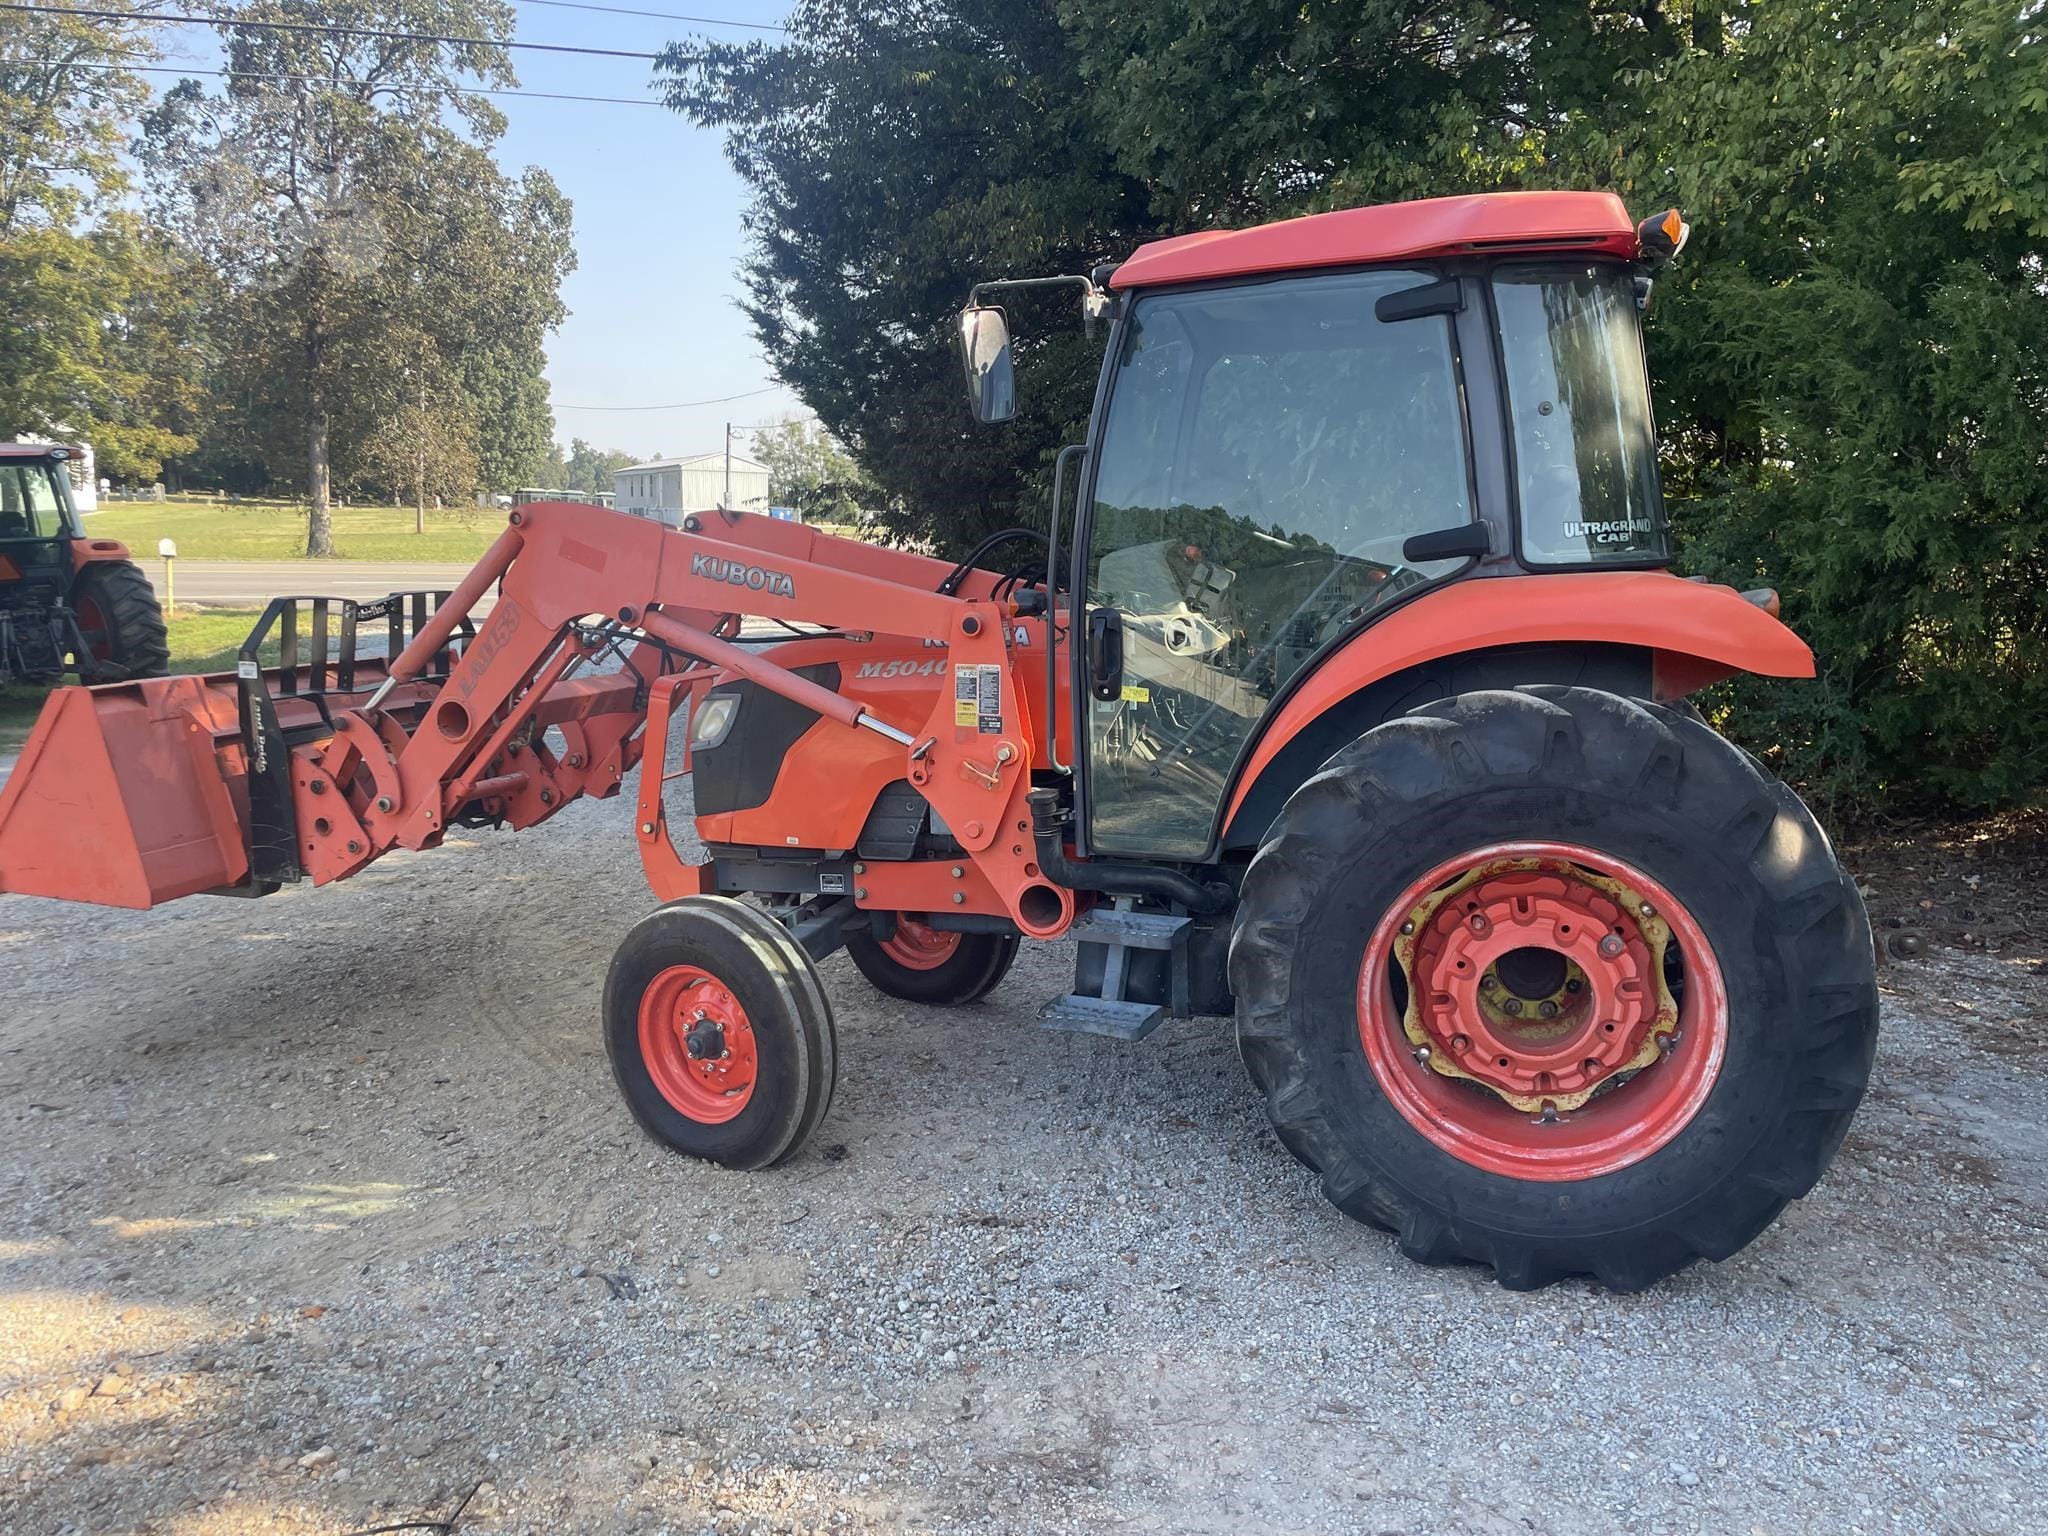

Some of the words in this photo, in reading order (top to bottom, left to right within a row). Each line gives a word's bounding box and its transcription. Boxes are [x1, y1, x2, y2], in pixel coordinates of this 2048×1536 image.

[1563, 518, 1651, 538] ULTRAGRAND
[1596, 533, 1630, 543] CAB
[691, 552, 795, 599] KUBOTA
